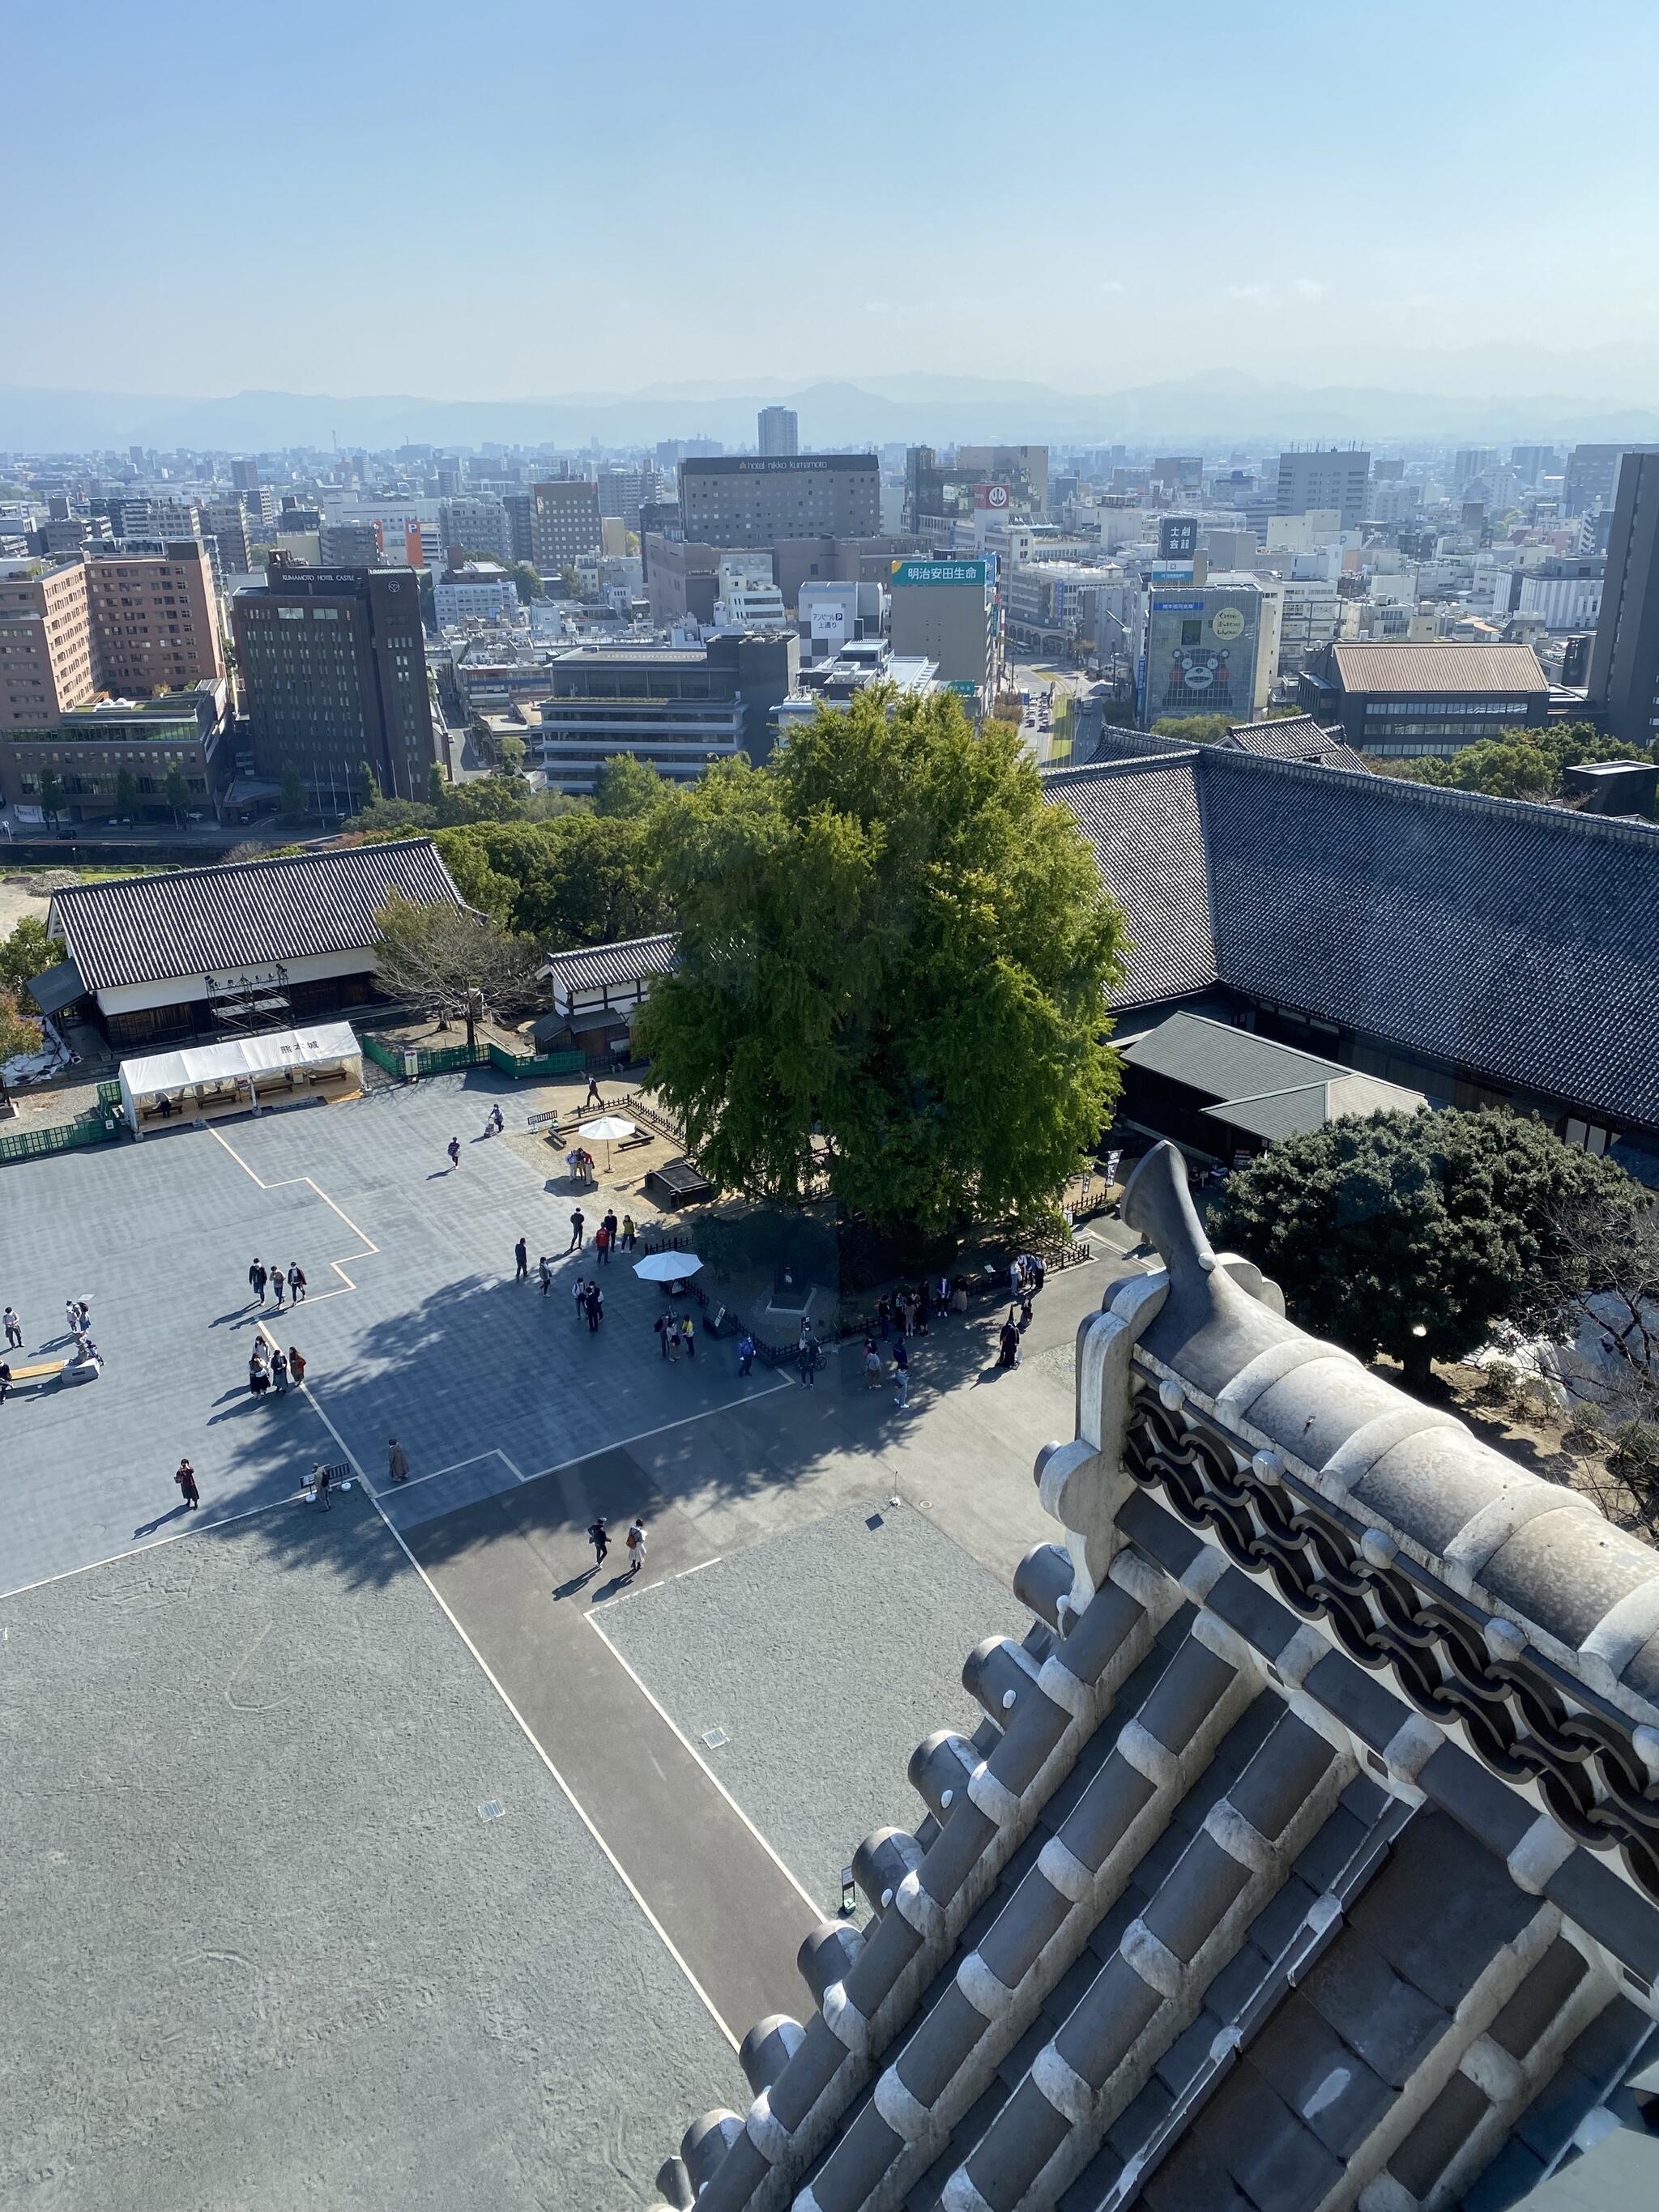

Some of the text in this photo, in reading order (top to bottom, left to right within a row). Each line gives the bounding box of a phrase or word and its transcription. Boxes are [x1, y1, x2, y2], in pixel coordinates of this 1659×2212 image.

[747, 460, 827, 470] hotel nikko kumamoto
[408, 523, 417, 533] P
[908, 566, 977, 580] 明治安田生命
